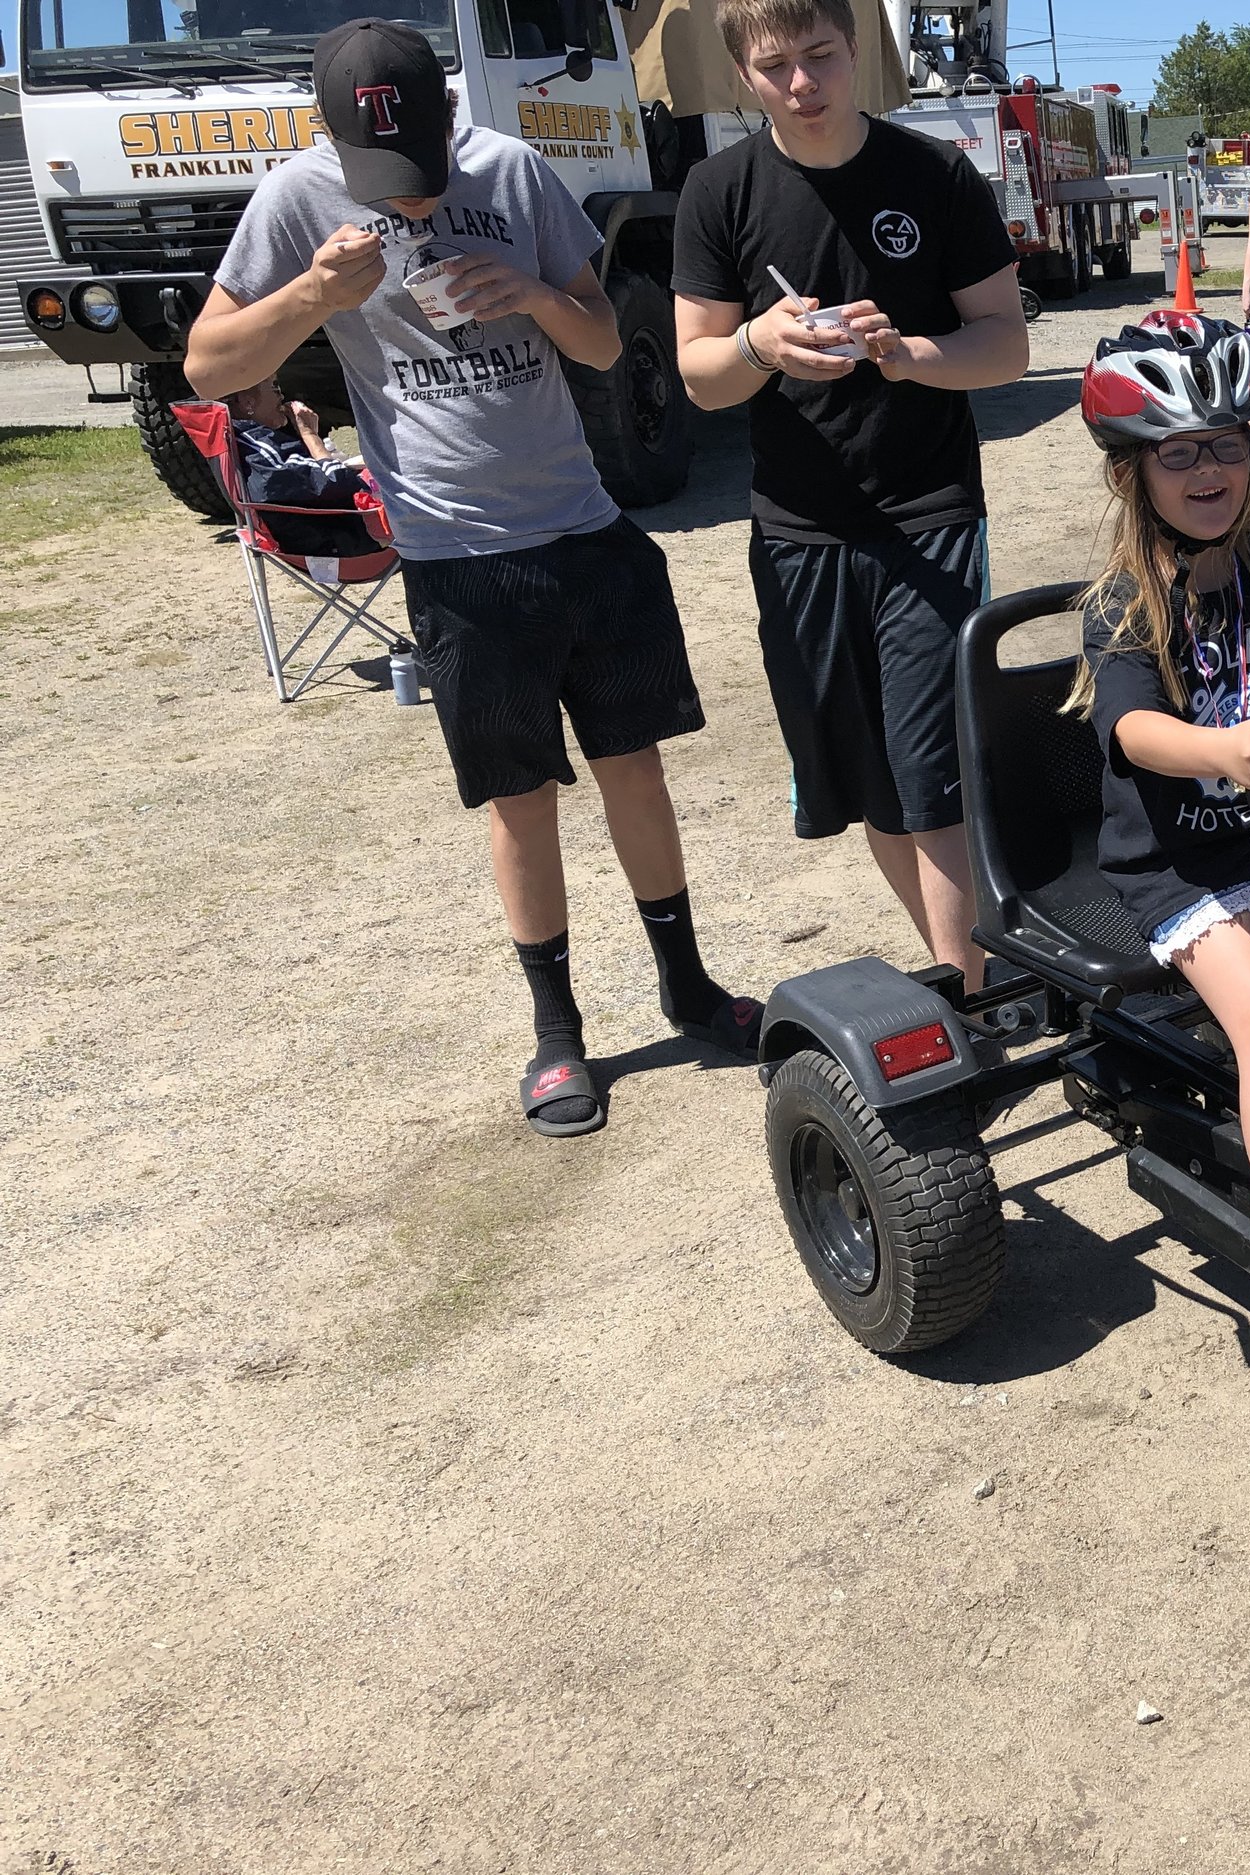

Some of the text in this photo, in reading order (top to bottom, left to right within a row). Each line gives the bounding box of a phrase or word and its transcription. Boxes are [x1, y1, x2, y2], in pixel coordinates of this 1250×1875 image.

[355, 85, 401, 135] T
[517, 101, 611, 142] SHERIFF
[118, 106, 329, 158] SHERIF
[581, 145, 615, 159] COUNTY
[130, 158, 254, 179] FRANKLIN
[444, 206, 514, 247] LAKE
[392, 340, 542, 389] FOOTBALL
[402, 367, 544, 402] TOGETHER WE SUCCEED
[538, 1064, 571, 1087] NIKE
